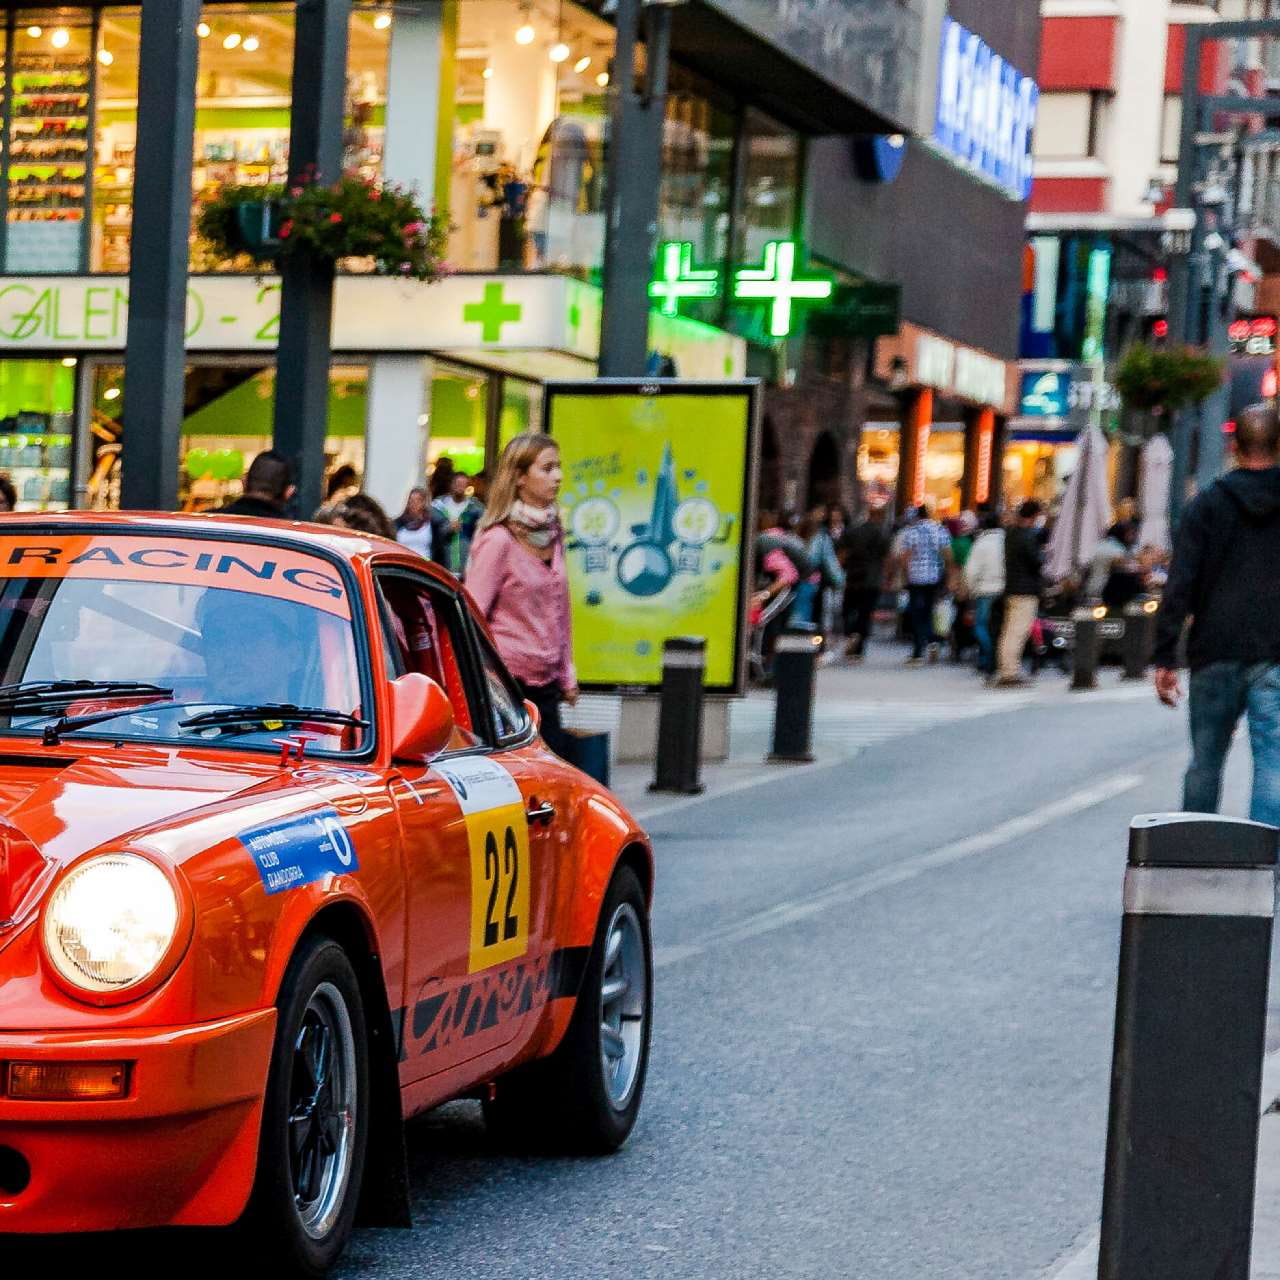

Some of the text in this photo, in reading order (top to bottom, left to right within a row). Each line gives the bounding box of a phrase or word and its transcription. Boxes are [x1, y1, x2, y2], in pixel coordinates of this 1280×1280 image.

[6, 546, 345, 599] RACING
[258, 851, 280, 868] CLUB
[483, 825, 519, 948] 22
